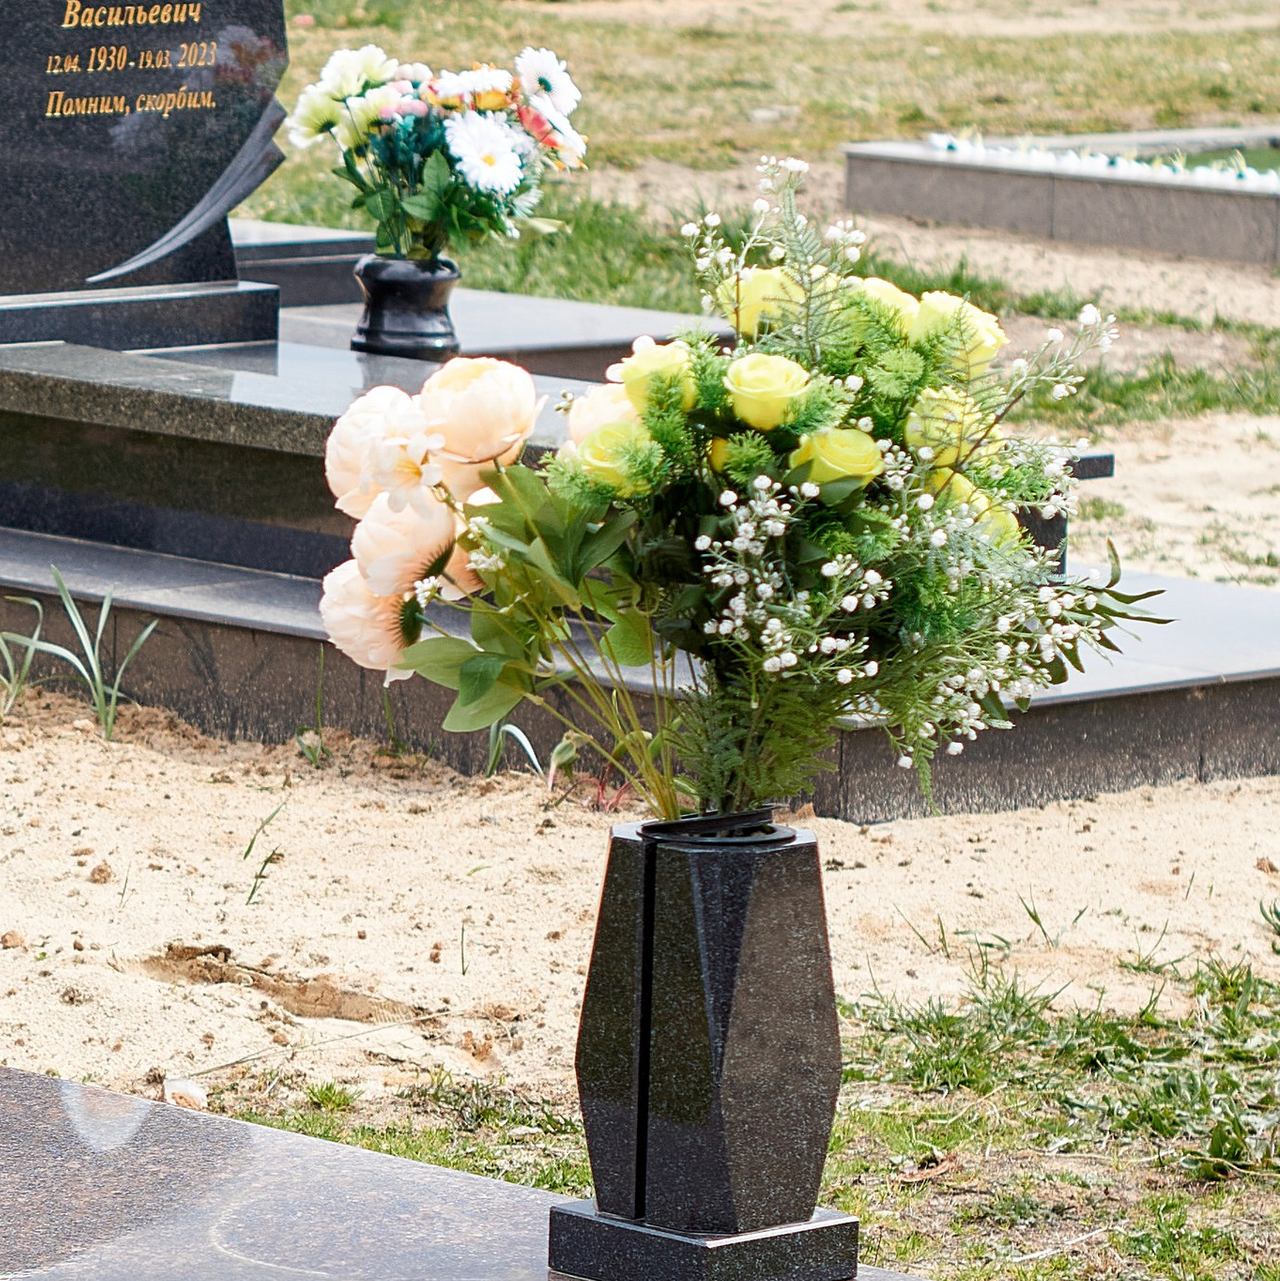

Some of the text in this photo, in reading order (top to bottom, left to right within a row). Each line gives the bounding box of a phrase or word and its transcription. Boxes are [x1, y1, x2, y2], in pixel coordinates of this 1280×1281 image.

[61, 0, 201, 28] Васильевич
[45, 85, 217, 118] Помним, скорбим.
